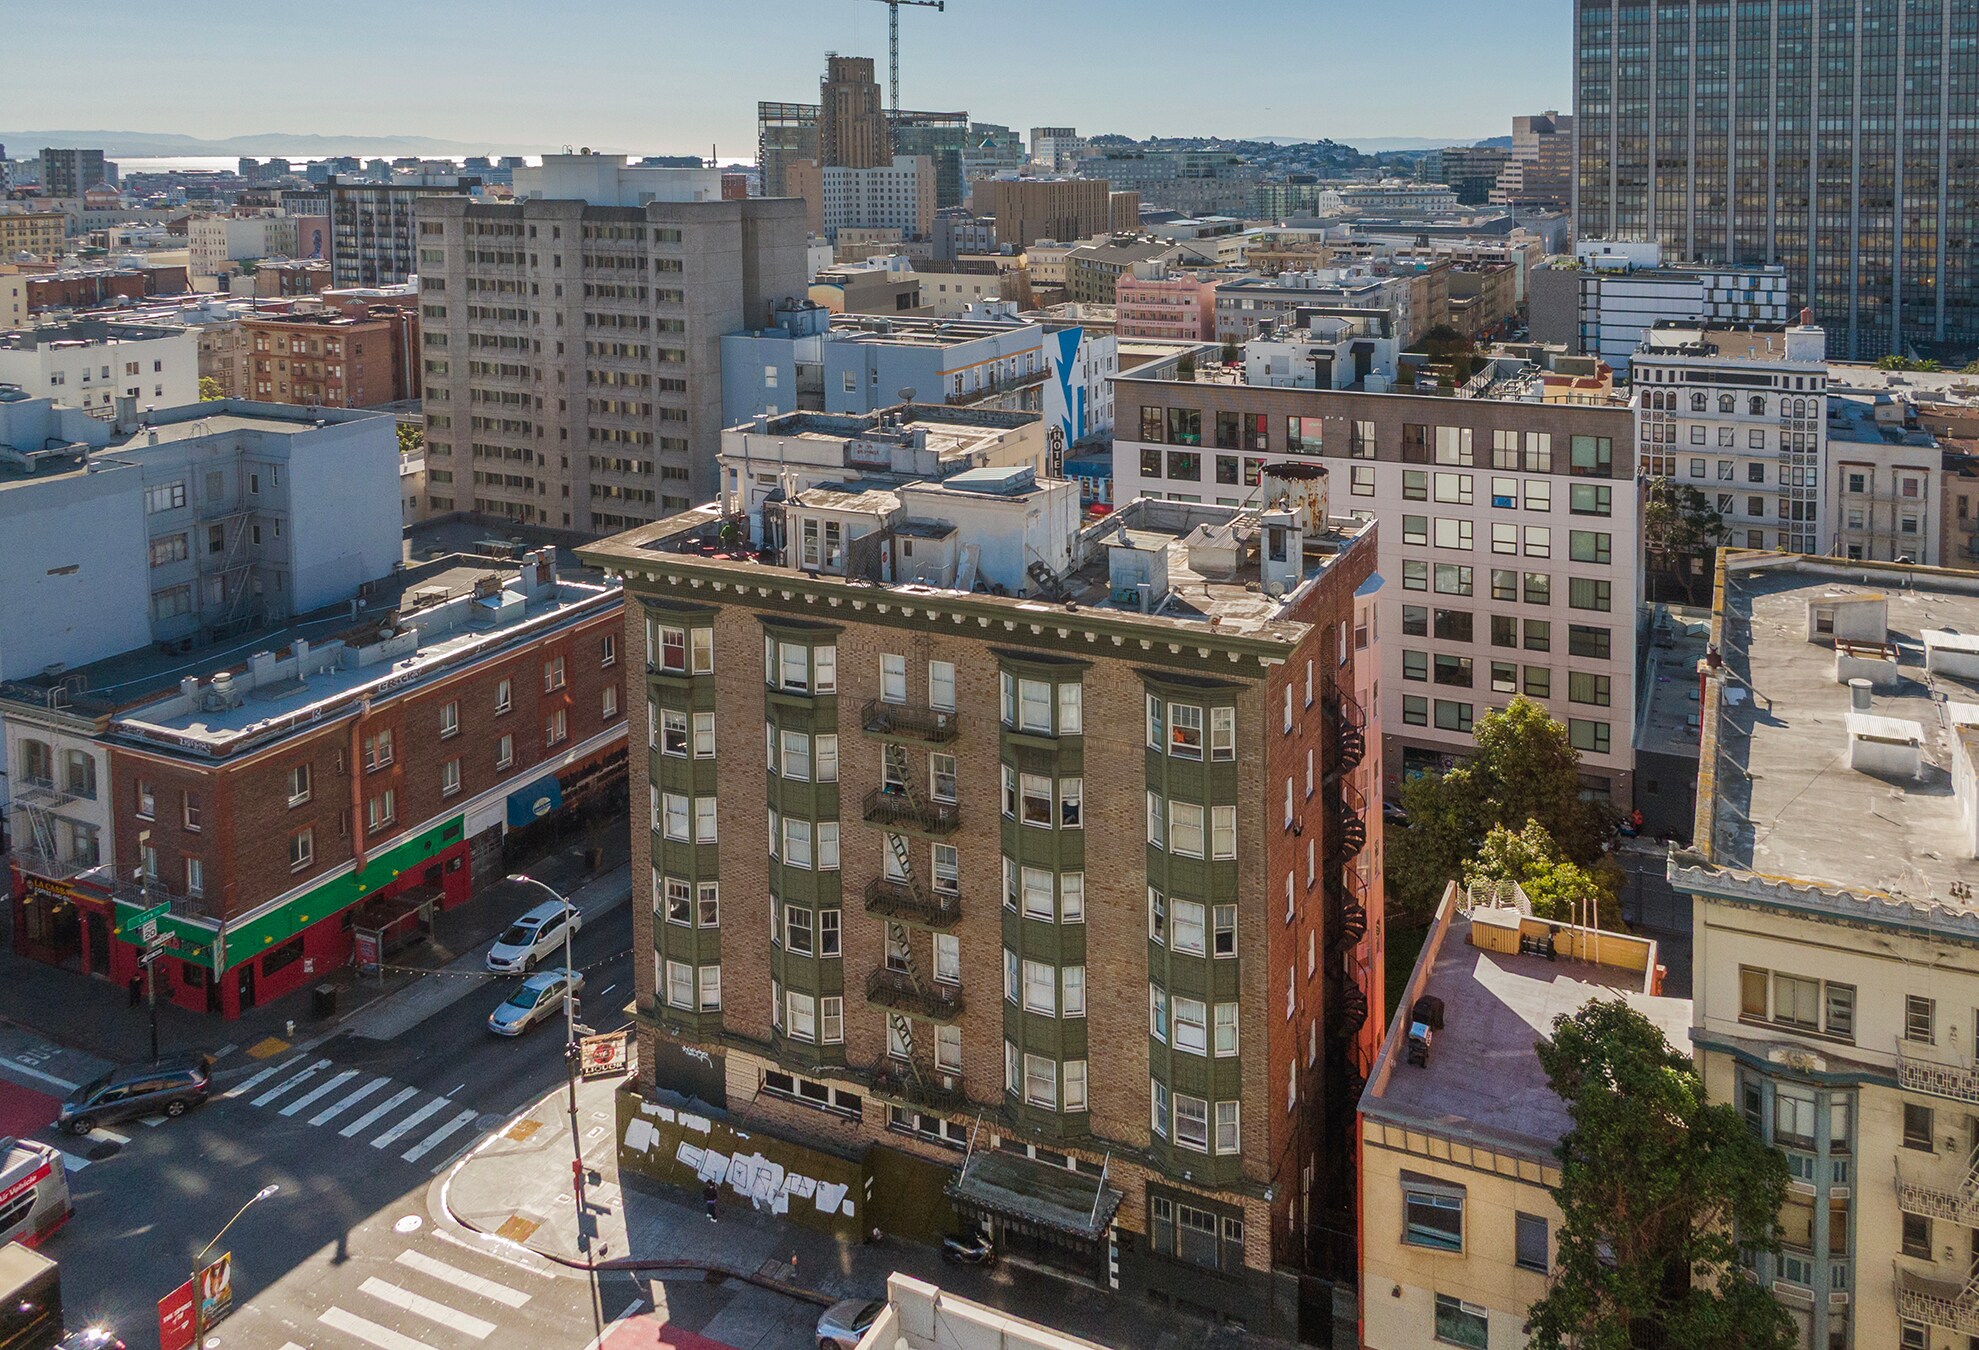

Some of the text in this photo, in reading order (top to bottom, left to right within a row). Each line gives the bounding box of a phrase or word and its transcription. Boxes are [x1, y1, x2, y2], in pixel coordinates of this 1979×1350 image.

[1052, 432, 1062, 478] HOTEL
[144, 928, 156, 940] 20
[584, 1061, 625, 1074] LIQUOR
[9, 1175, 37, 1195] Vehicle
